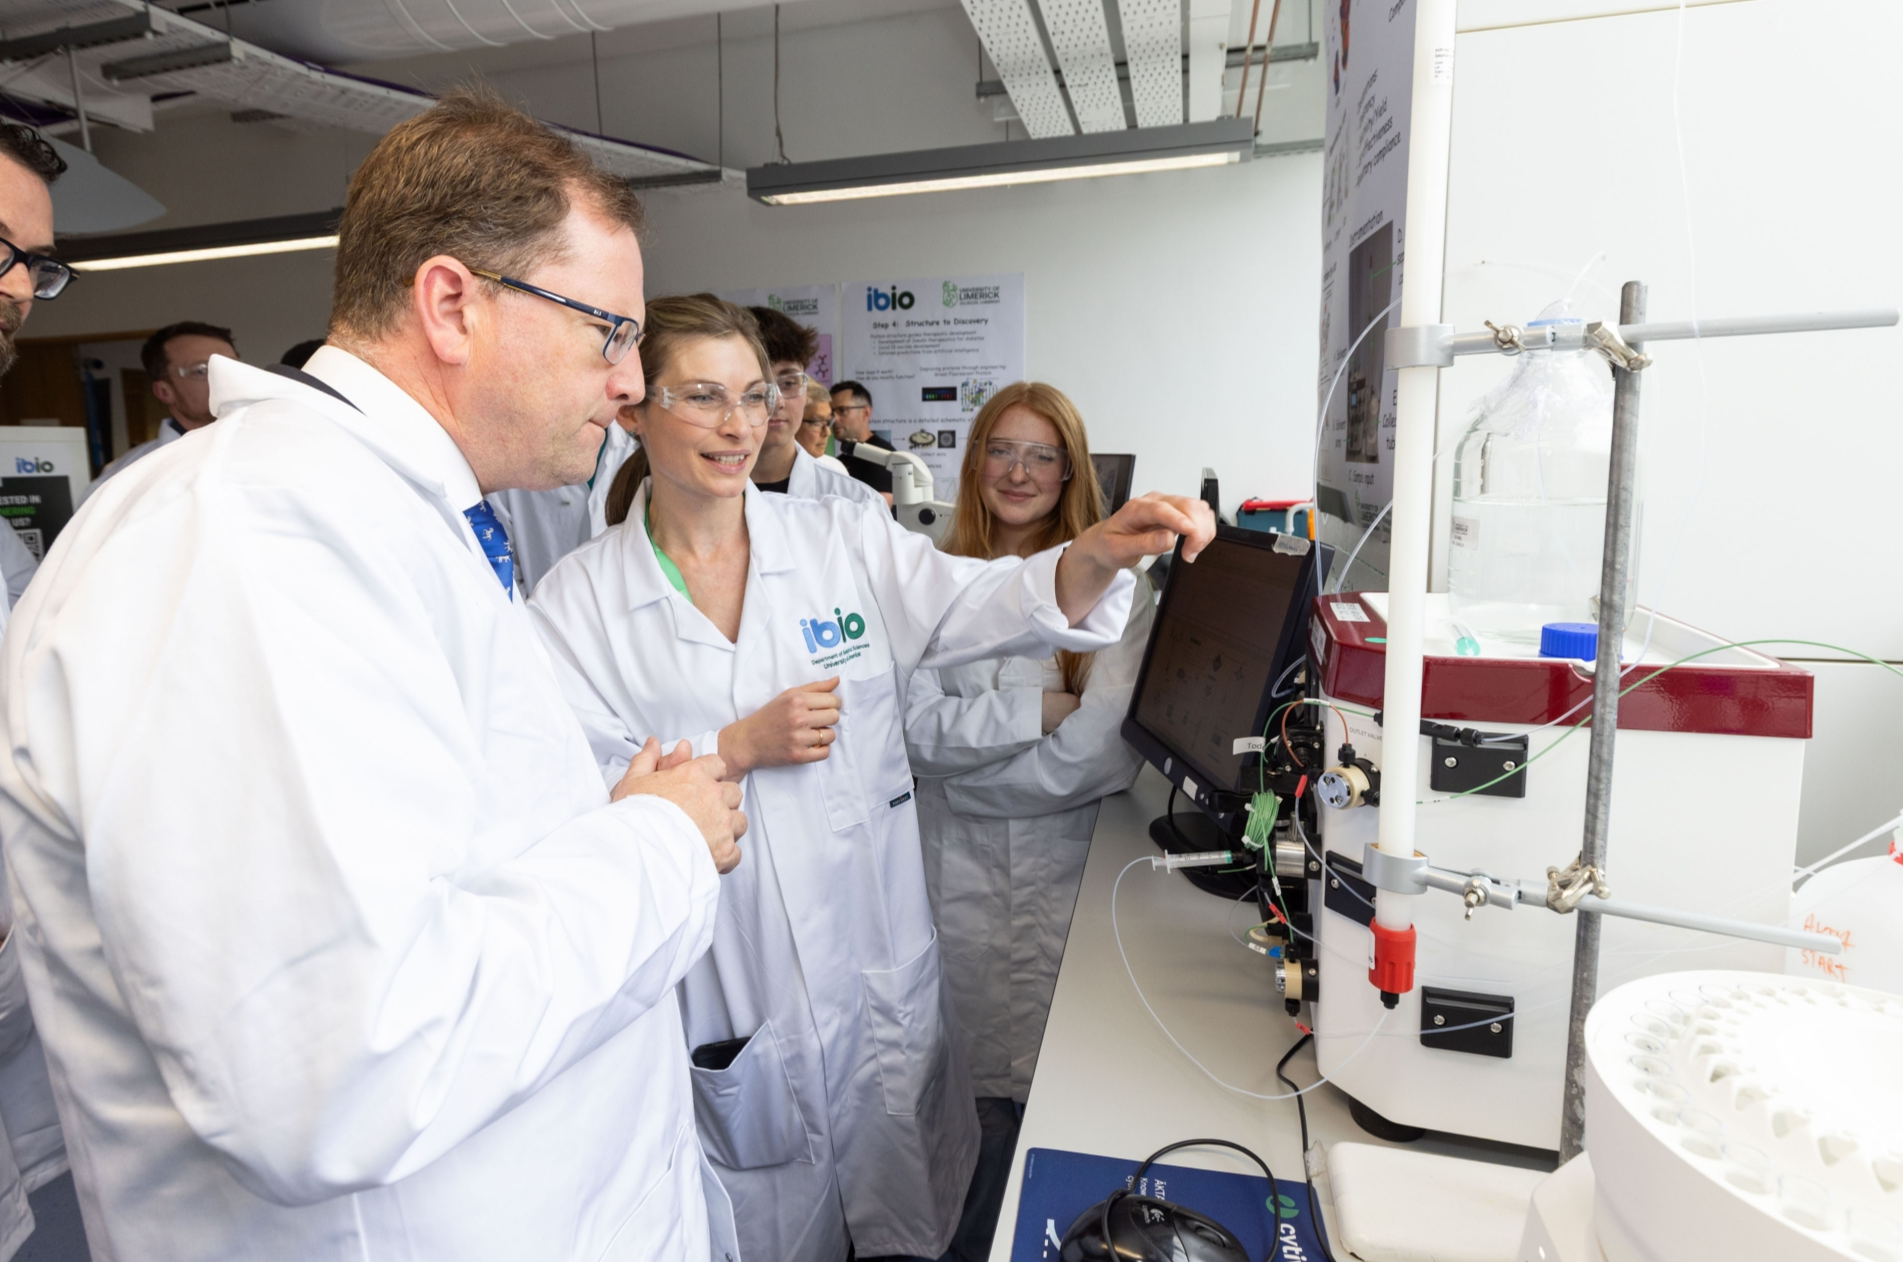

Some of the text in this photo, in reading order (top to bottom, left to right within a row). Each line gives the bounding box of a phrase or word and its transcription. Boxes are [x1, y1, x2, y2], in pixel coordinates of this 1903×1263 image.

[867, 285, 915, 311] ibio
[959, 291, 1000, 301] LIMERICK
[783, 303, 819, 312] LIMERICK
[873, 322, 889, 330] Step
[905, 320, 940, 328] Structure
[954, 318, 989, 326] Discovery
[15, 457, 54, 473] ibio
[800, 607, 866, 654] ibio
[811, 653, 839, 666] Department
[1802, 948, 1854, 985] START
[1280, 1223, 1307, 1262] cyti
